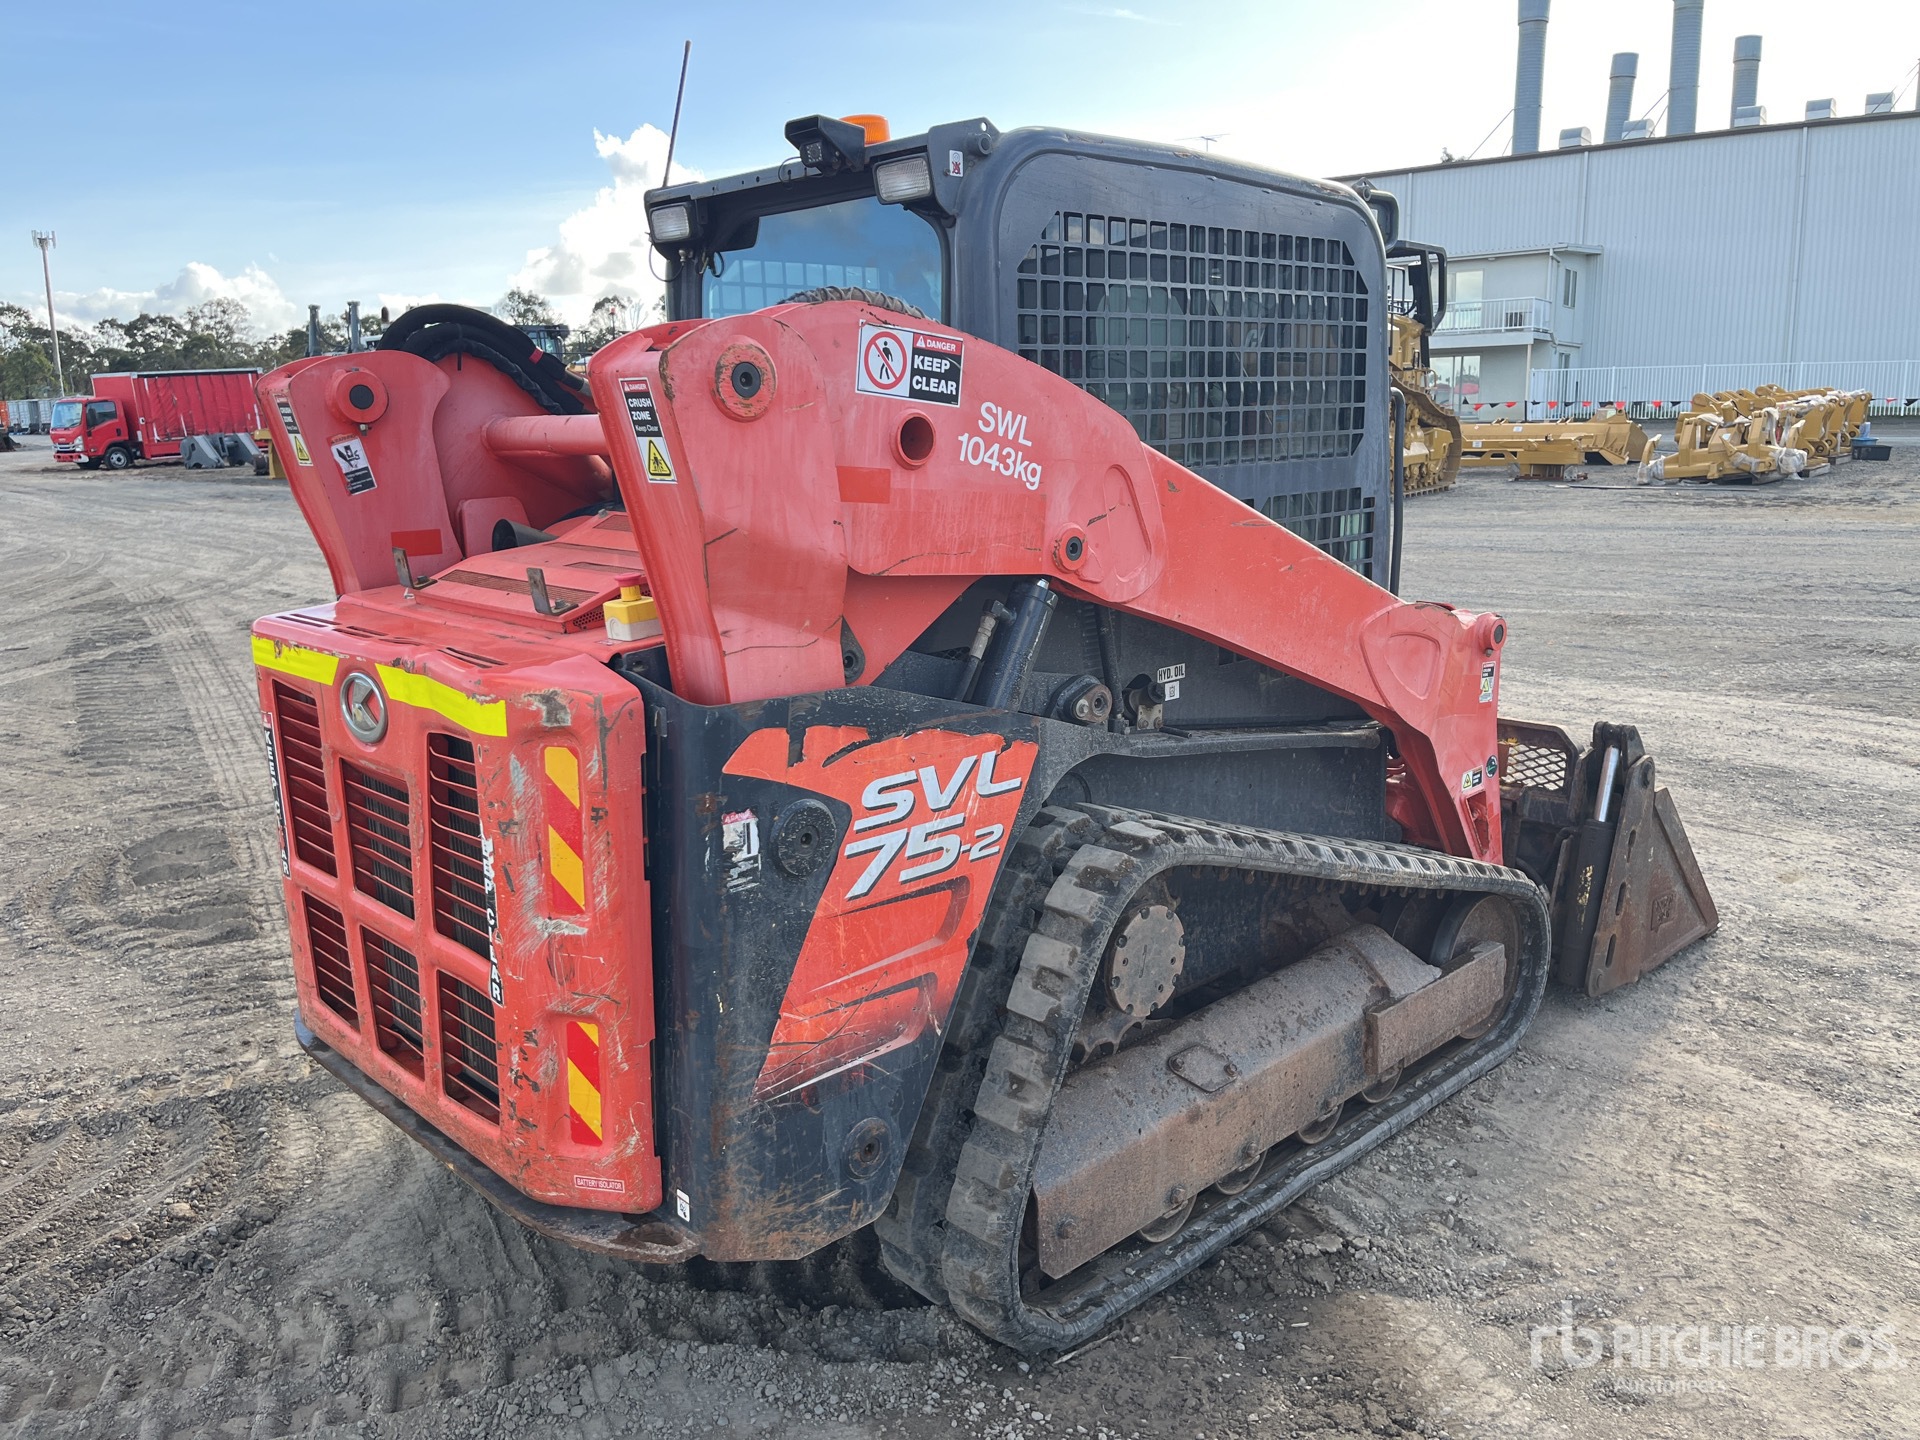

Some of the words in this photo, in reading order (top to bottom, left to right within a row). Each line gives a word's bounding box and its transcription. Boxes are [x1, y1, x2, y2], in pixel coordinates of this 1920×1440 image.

[926, 338, 956, 353] DANGER
[913, 354, 951, 374] KEEP
[912, 375, 957, 395] CLEAR
[628, 398, 652, 407] CRUSH
[631, 411, 652, 420] ZONE
[977, 401, 1033, 447] SWL
[635, 424, 647, 432] Keep
[647, 424, 659, 432] Clear
[958, 432, 1043, 491] 1043kg
[1158, 668, 1173, 681] HYD.
[1174, 665, 1184, 677] OIL
[853, 750, 1022, 833] SVL
[844, 812, 1004, 901] 75-2
[577, 1178, 598, 1188] BATTERY
[598, 1180, 622, 1190] ISOLATOR
